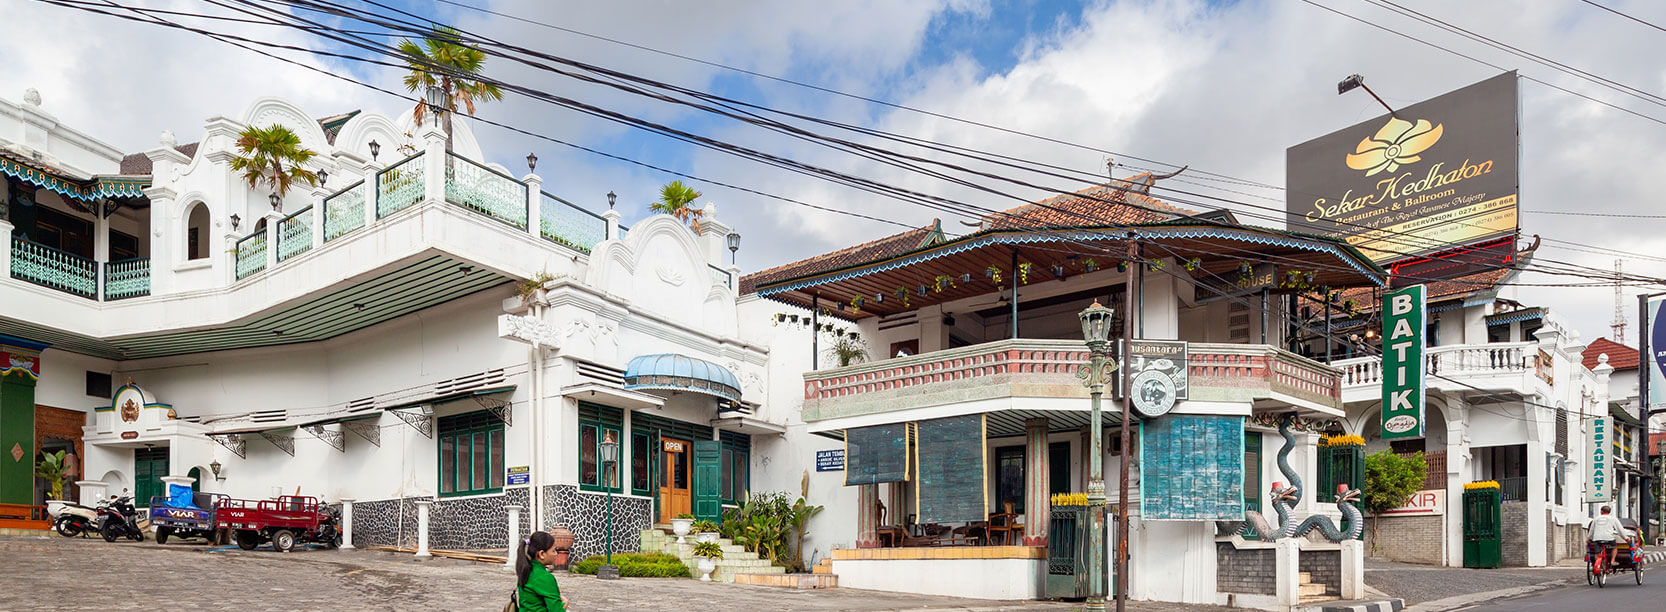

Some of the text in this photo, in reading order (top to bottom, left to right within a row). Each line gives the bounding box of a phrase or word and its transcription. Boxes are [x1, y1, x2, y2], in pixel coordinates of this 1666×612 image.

[1305, 158, 1493, 223] Sekar Kedhaton
[1452, 192, 1486, 206] Majesty
[1335, 188, 1455, 227] Restaurant & Ballroom
[1390, 294, 1414, 411] BATIK
[665, 442, 682, 450] OPEN
[1593, 419, 1604, 491] RESTAURANT
[168, 509, 195, 518] VIAR
[1402, 493, 1436, 508] KIR
